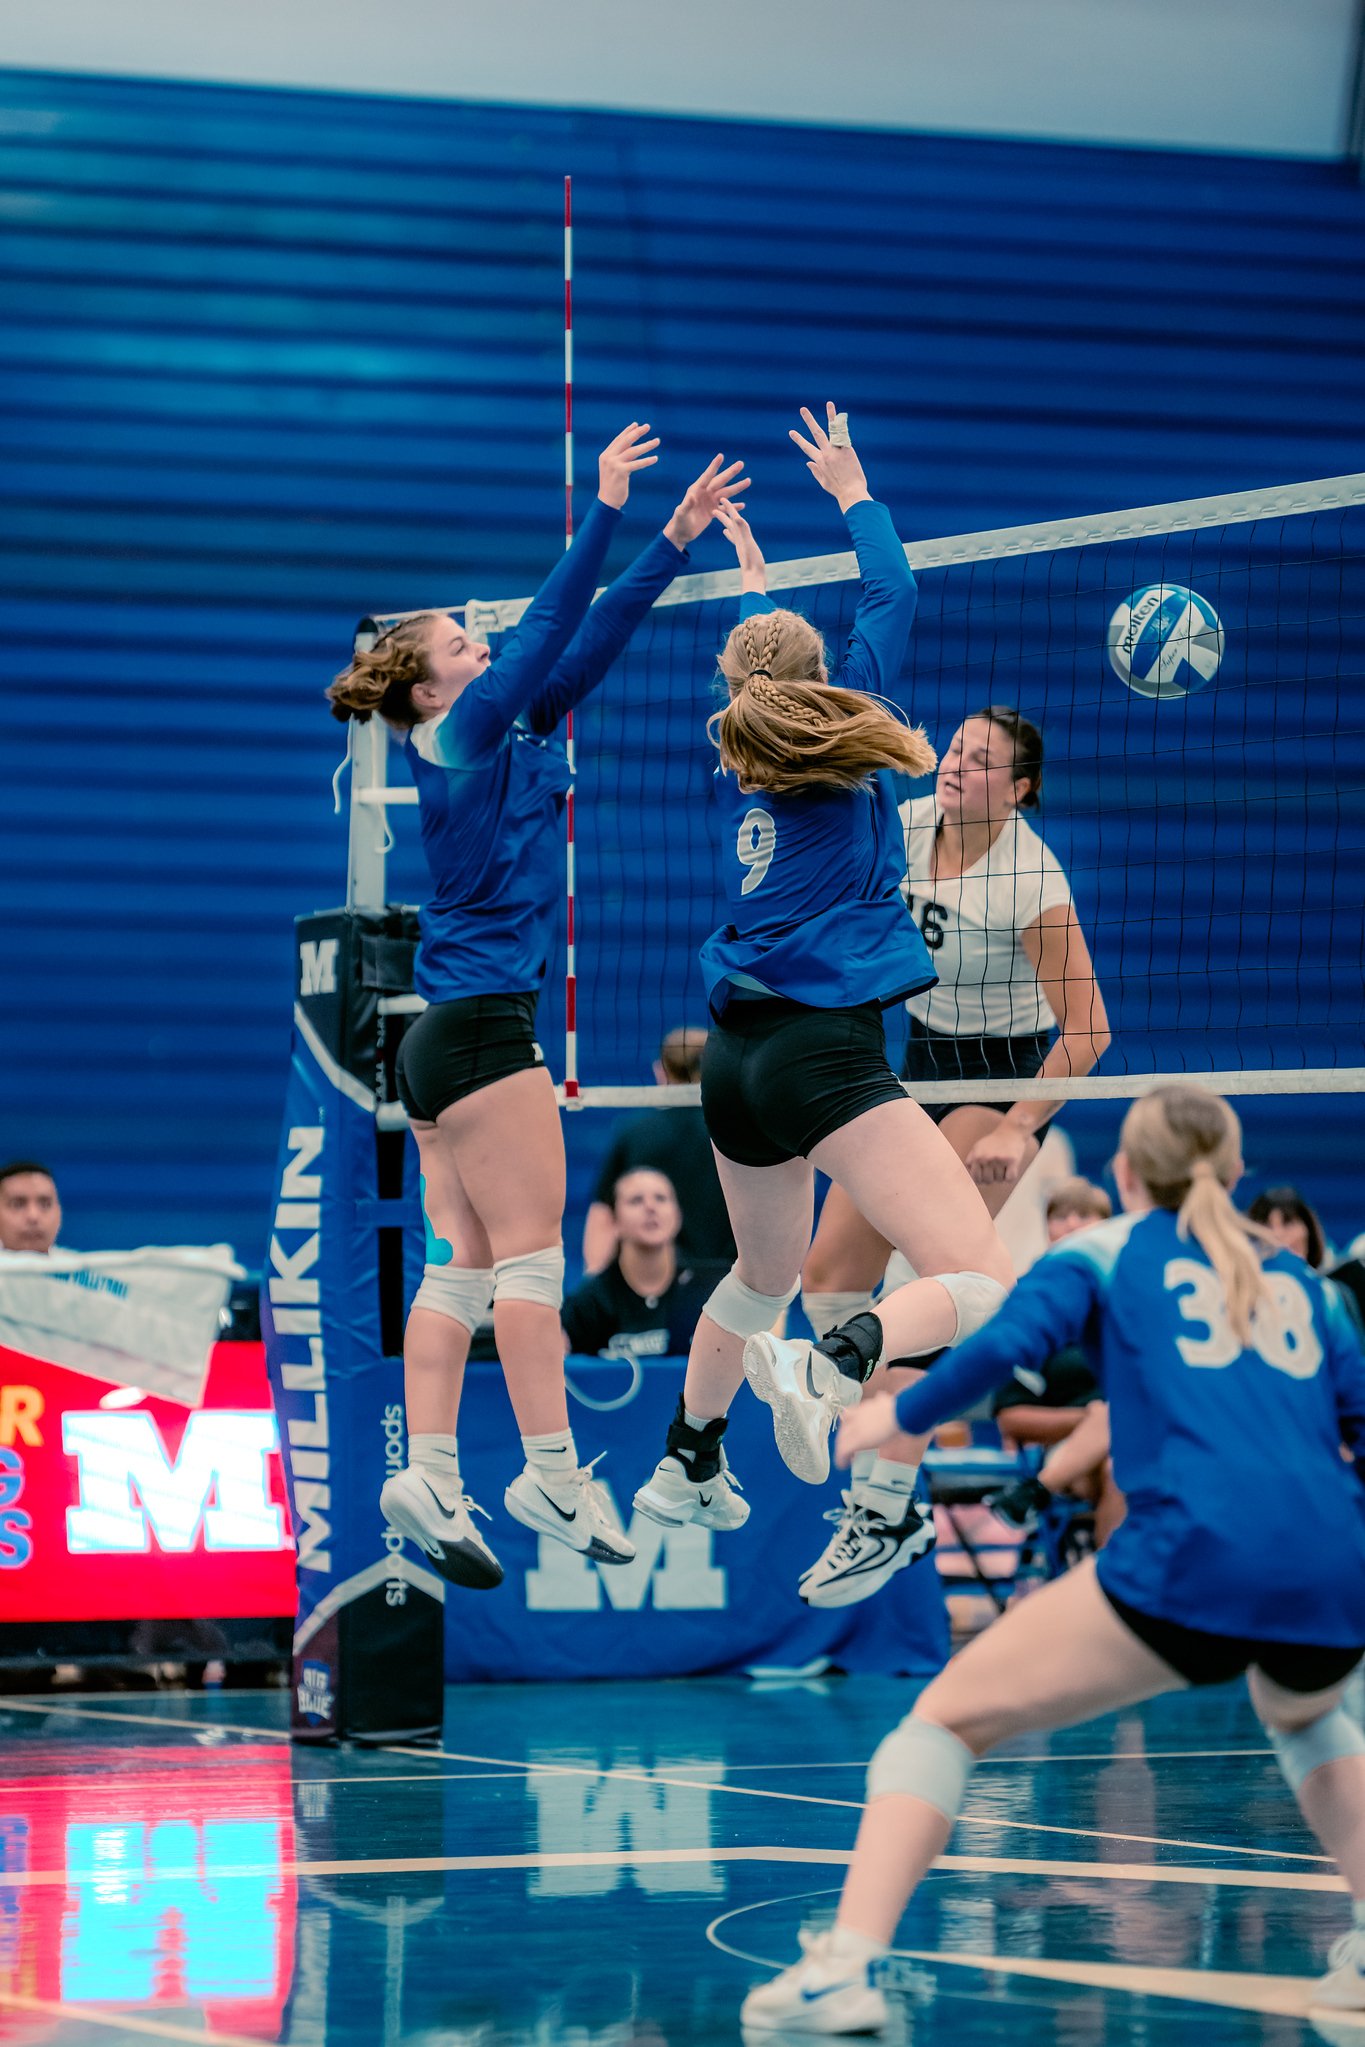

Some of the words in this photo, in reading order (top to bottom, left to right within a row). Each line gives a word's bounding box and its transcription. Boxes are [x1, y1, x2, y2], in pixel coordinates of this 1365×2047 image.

[1123, 597, 1159, 654] molten
[737, 807, 777, 896] 9
[300, 938, 339, 996] M
[269, 1126, 332, 1572] MILLIKIN
[1163, 1257, 1324, 1380] 38
[62, 1410, 282, 1553] M
[525, 1477, 728, 1611] M
[297, 1685, 334, 1720] BLUE
[303, 1667, 328, 1690] BIG
